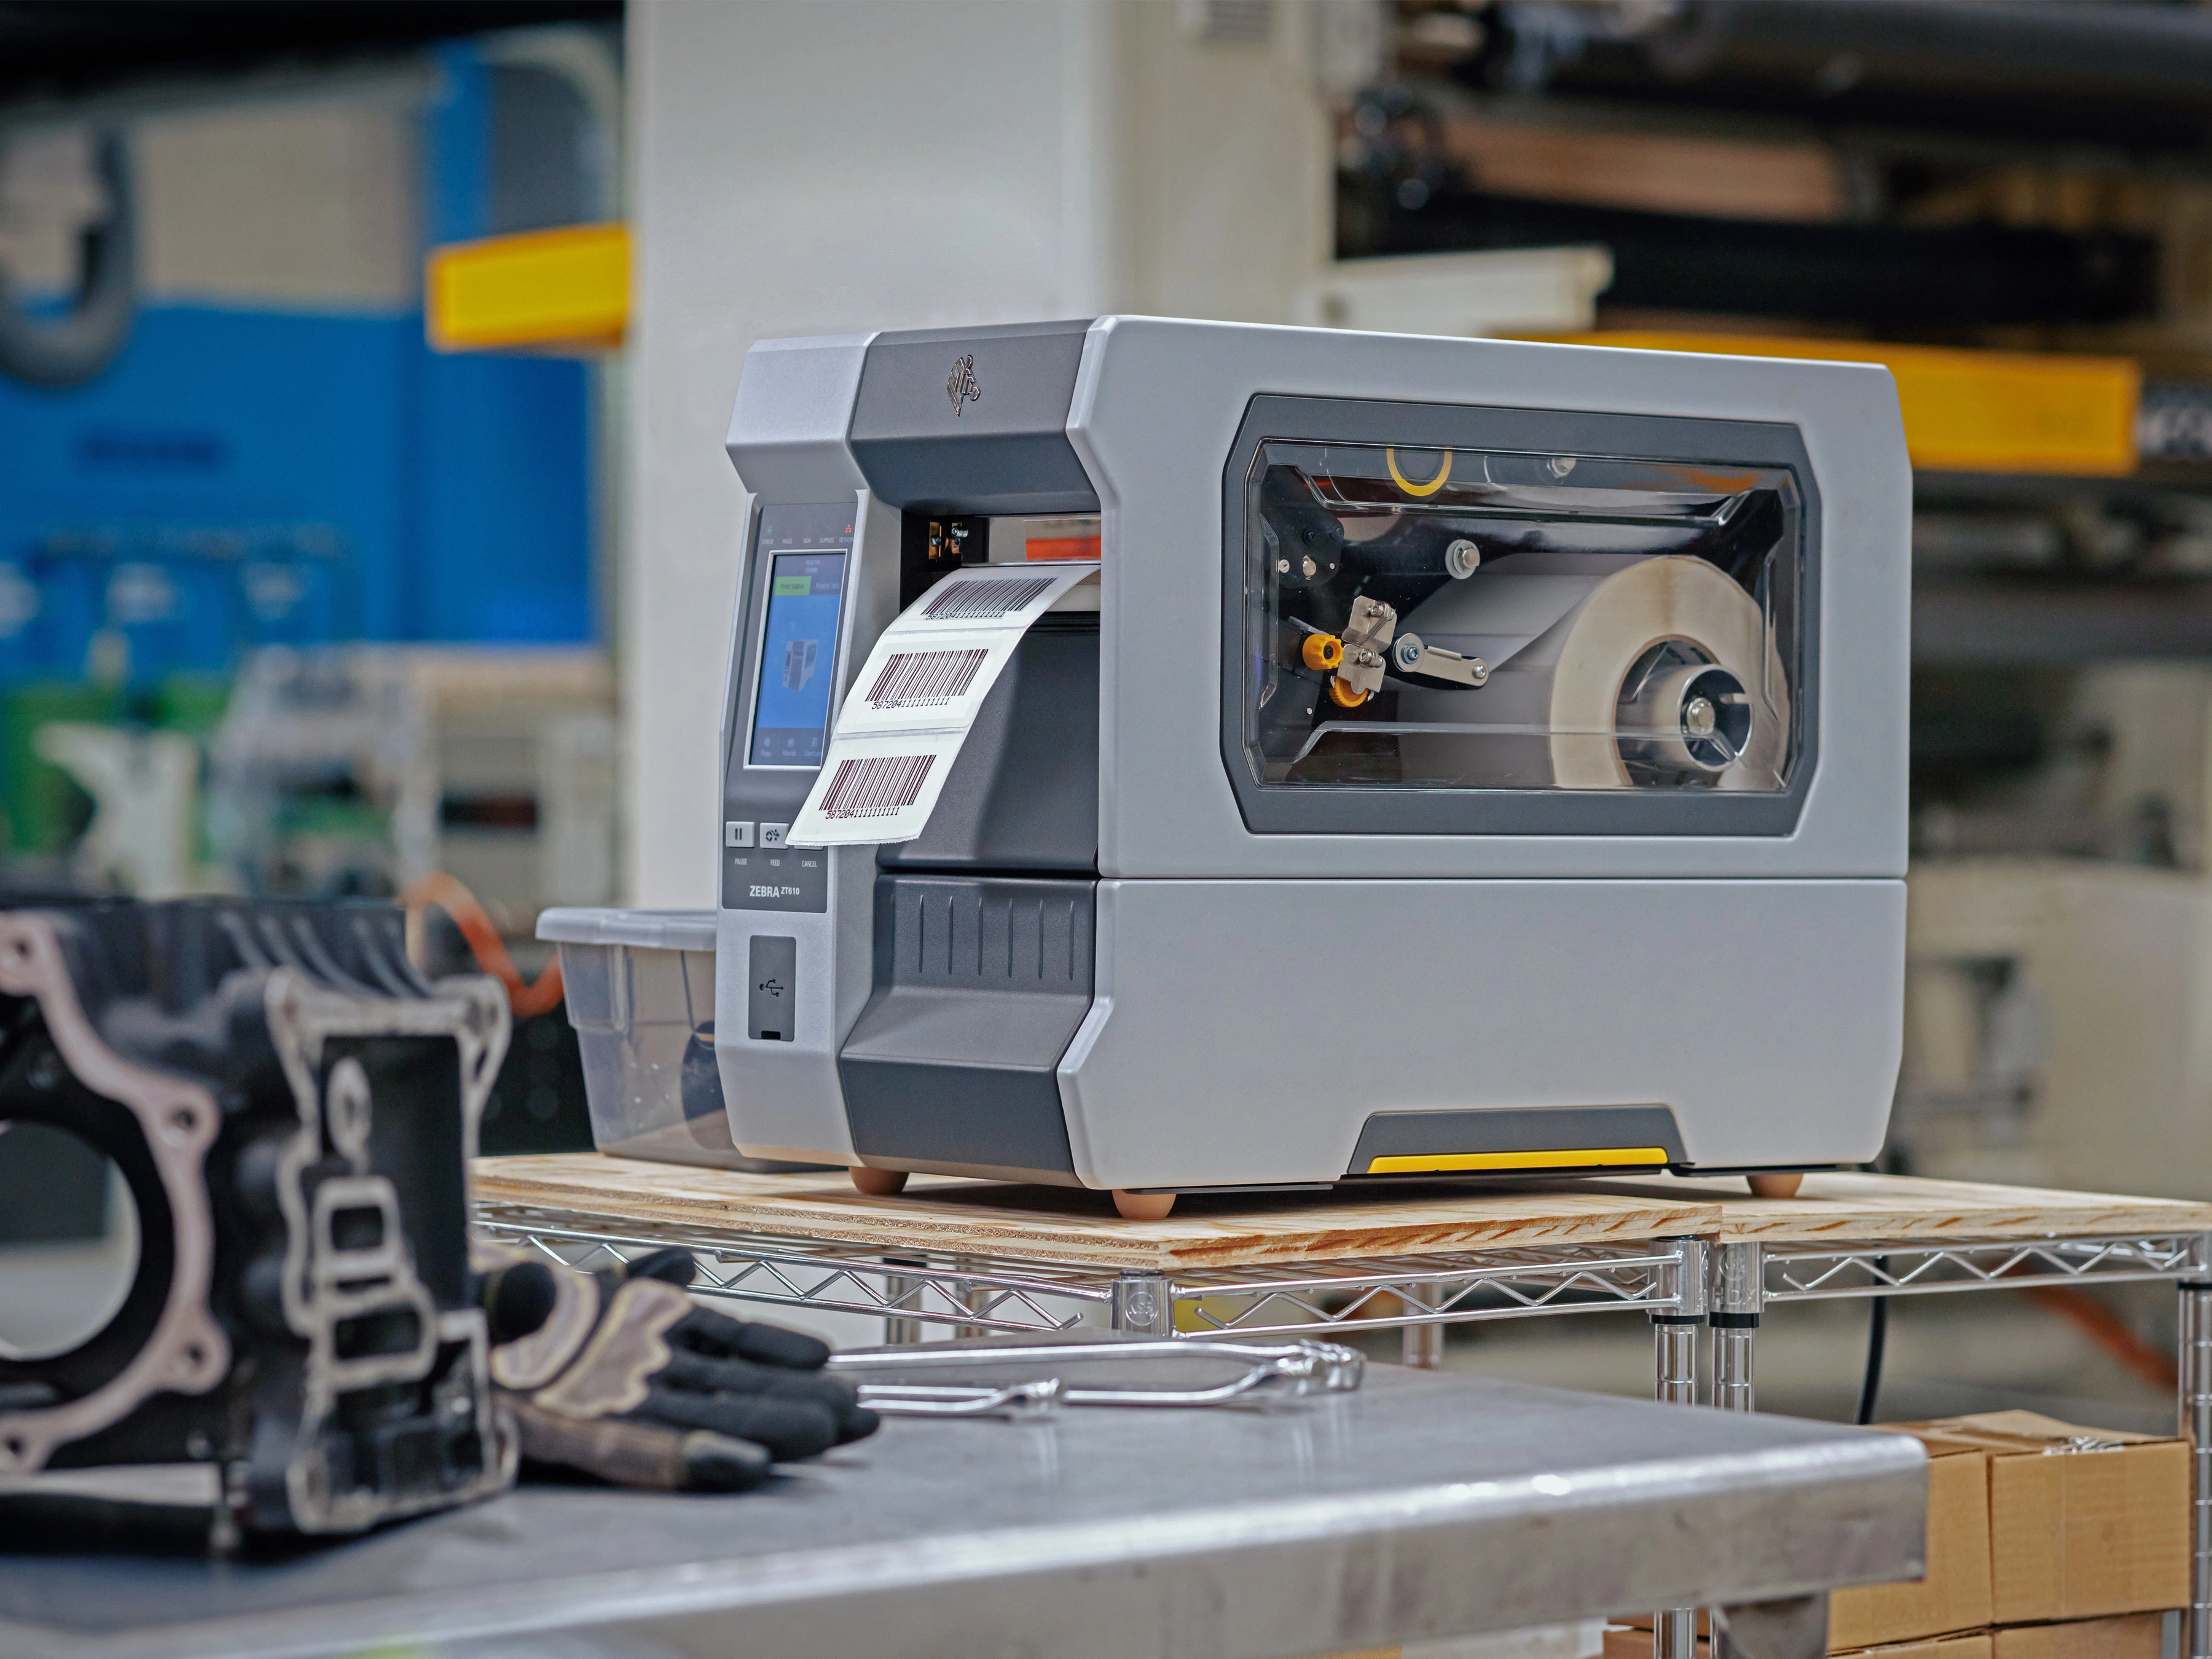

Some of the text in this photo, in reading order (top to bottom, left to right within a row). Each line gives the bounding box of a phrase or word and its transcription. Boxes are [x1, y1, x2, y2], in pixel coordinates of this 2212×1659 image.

[871, 697, 950, 710] 5872041111111111
[825, 806, 900, 820] 5872041111111111
[750, 885, 800, 898] ZEBRA ZT610
